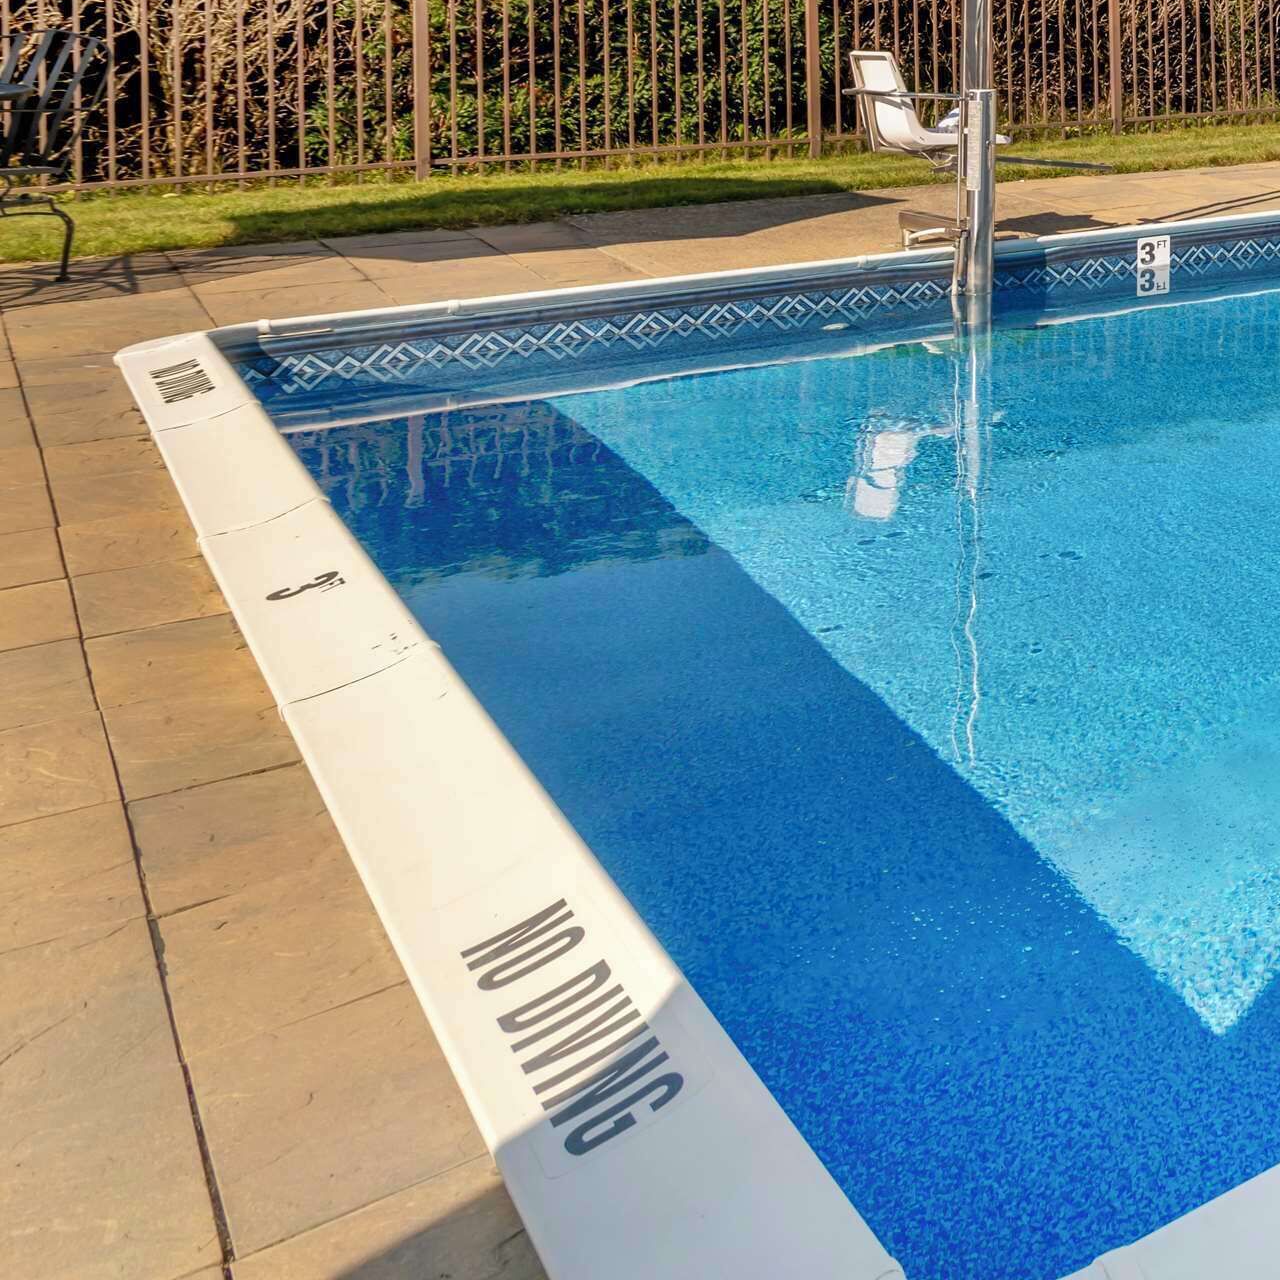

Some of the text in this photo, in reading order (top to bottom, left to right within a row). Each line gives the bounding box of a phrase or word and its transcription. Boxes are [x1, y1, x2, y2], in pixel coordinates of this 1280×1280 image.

[1140, 240, 1167, 265] 3 FT
[148, 358, 216, 404] NO DIVING
[265, 571, 339, 601] 3
[460, 898, 684, 1156] NO DIVING
